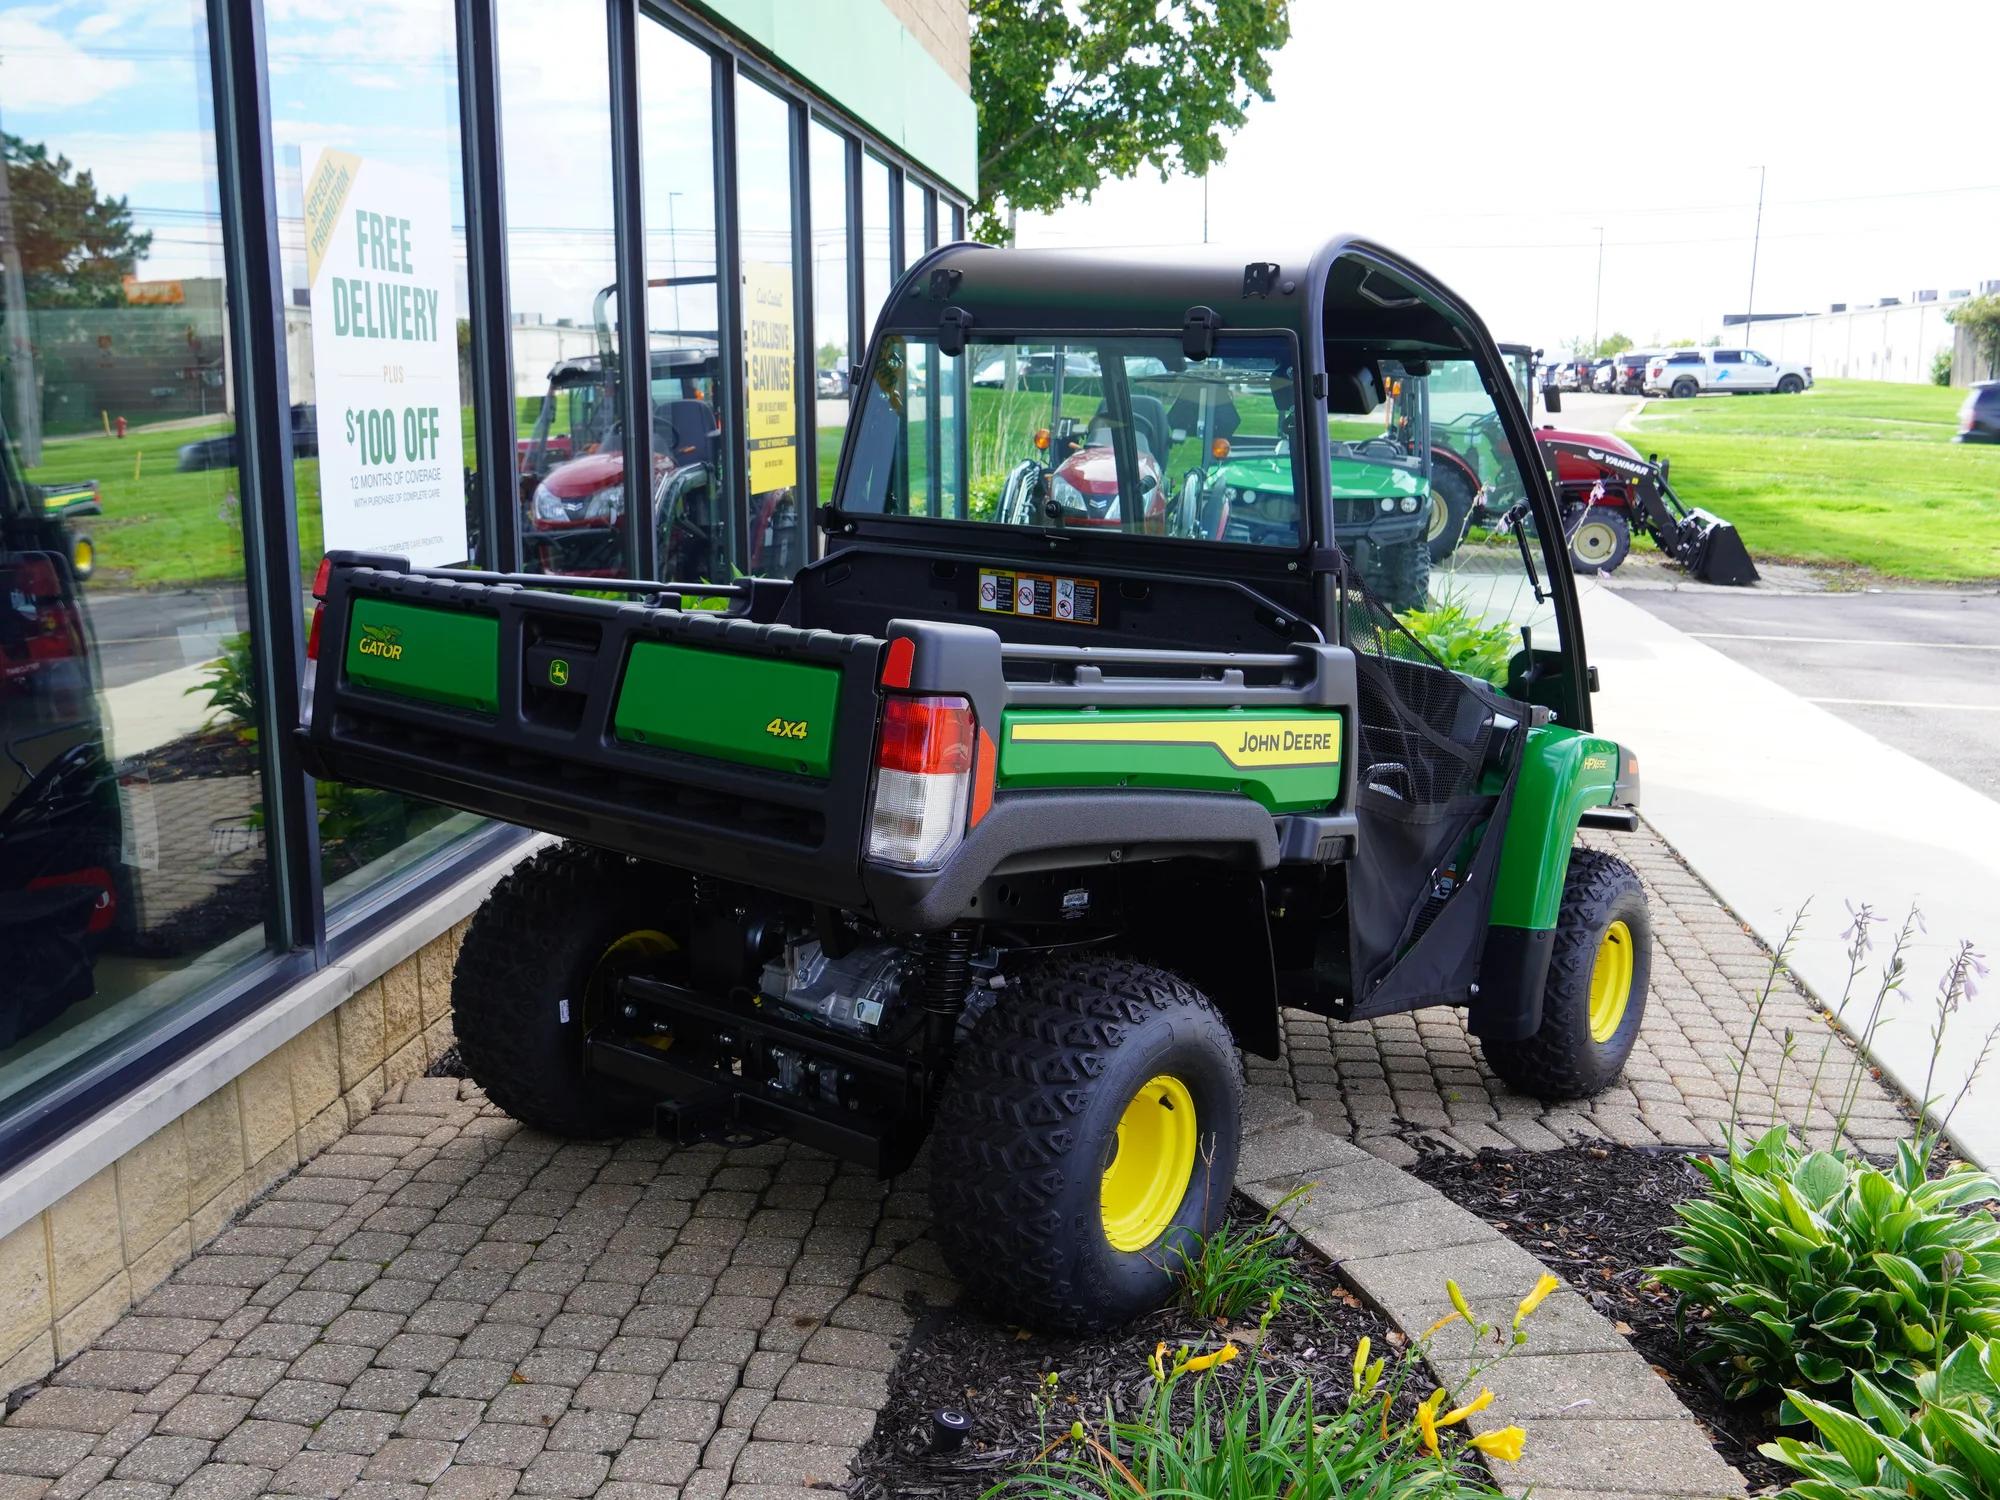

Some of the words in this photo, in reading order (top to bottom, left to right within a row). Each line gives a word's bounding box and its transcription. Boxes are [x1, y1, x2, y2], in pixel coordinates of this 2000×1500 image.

[307, 158, 336, 224] SPECIAL
[311, 165, 350, 257] PROMOTION
[356, 209, 413, 275] FREE
[332, 277, 438, 342] DELIVERY
[752, 320, 789, 350] EXCLUSIVE
[383, 365, 404, 383] PLUS
[753, 354, 790, 392] SAVINGS
[346, 405, 397, 466] $100
[403, 407, 440, 462] OFF
[351, 476, 359, 490] 12
[360, 472, 392, 489] MONTHS
[394, 471, 403, 485] OF
[405, 467, 442, 484] COVERAGE
[1604, 454, 1650, 476] YANMAR
[354, 497, 368, 508] WITH
[368, 494, 394, 506] PURCHASE
[396, 493, 403, 502] OF
[403, 490, 427, 502] COMPLETE
[428, 488, 440, 498] CARE
[359, 638, 402, 660] GATOR
[1238, 731, 1280, 753] JOHN
[1283, 730, 1332, 751] DEERE
